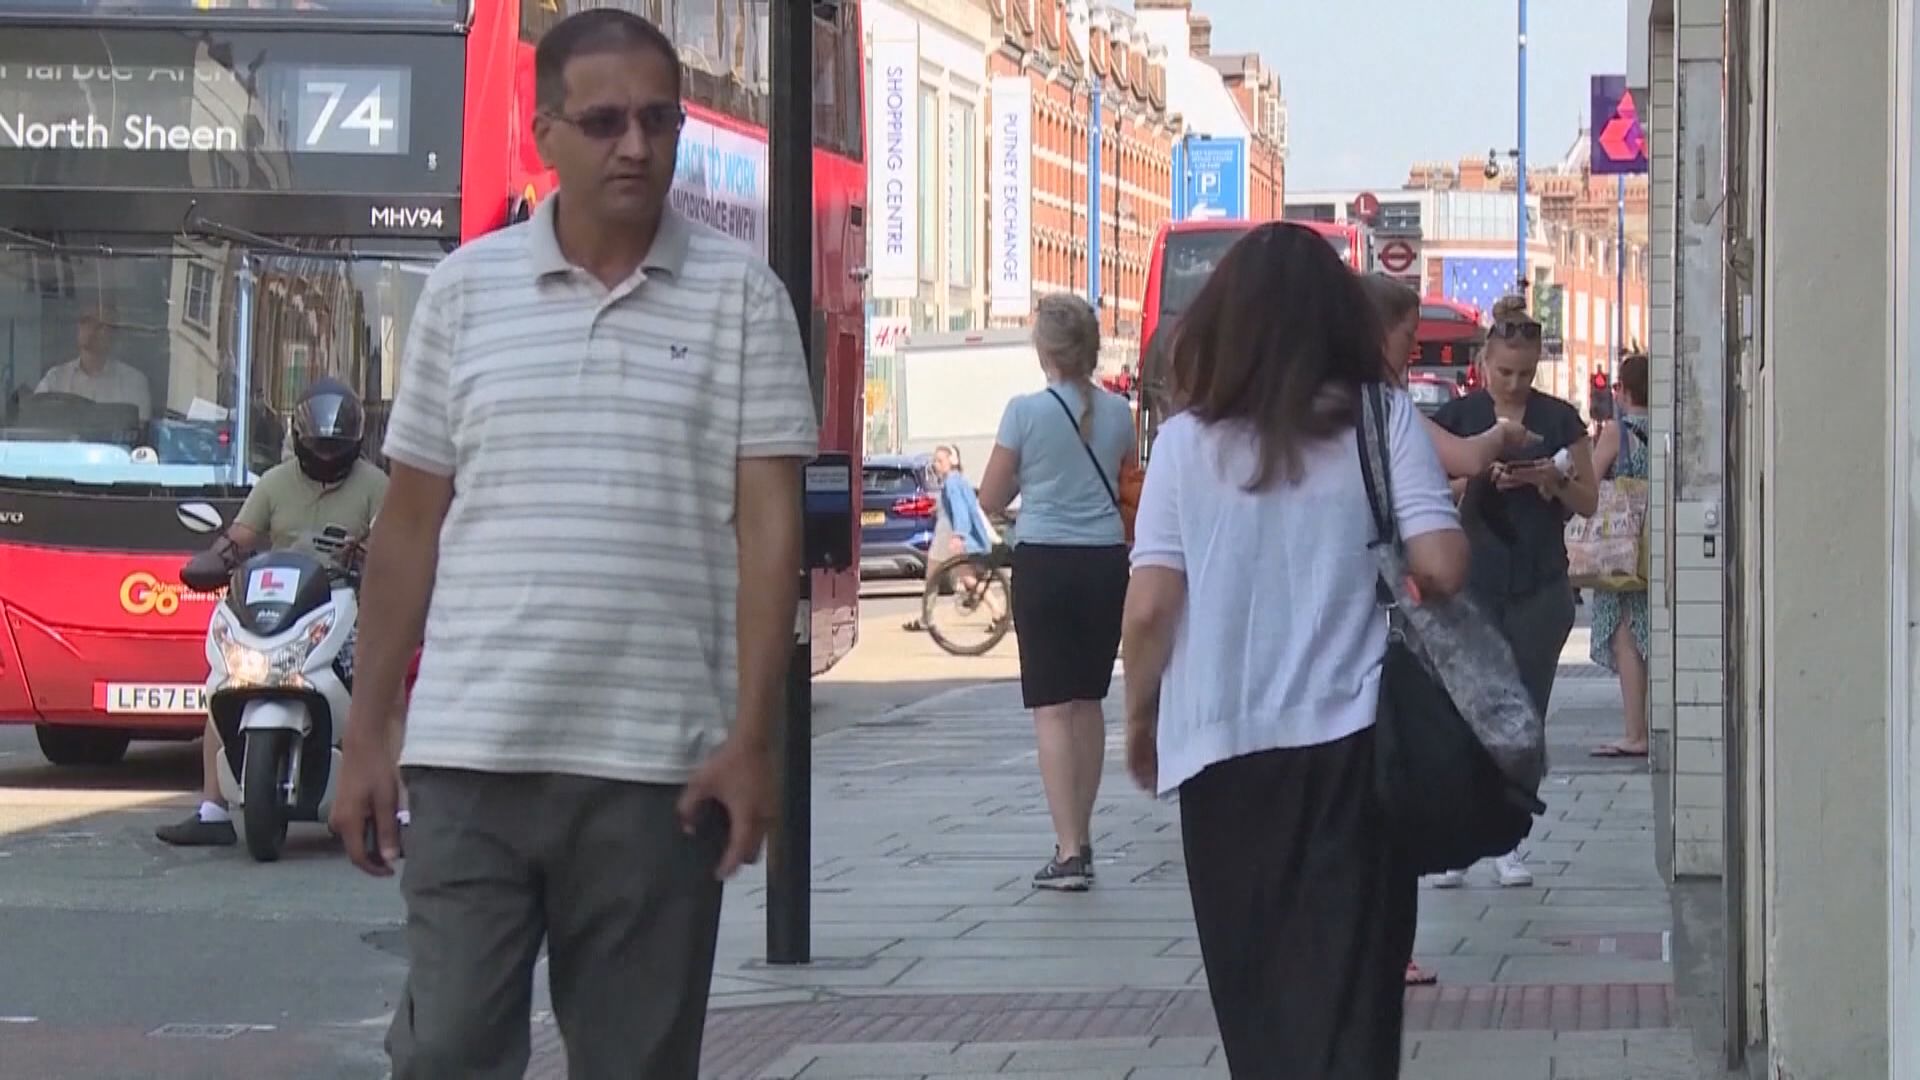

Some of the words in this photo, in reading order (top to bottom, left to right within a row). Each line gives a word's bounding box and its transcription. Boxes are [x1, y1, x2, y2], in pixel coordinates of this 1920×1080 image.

[0, 113, 108, 149] North
[123, 114, 237, 151] Sheen
[306, 82, 393, 145] 74
[887, 66, 902, 169] SHOPPING
[1004, 113, 1017, 177] PUTNEY
[725, 152, 756, 199] WORK
[1202, 174, 1217, 194] P
[371, 206, 443, 228] MHV94
[673, 189, 727, 231] WORKSPACE
[887, 179, 902, 254] CENTRE
[1361, 198, 1371, 214] L
[1004, 186, 1017, 281] EXCHANGE
[120, 572, 178, 616] Go
[261, 570, 284, 589] L
[118, 687, 176, 709] LF67
